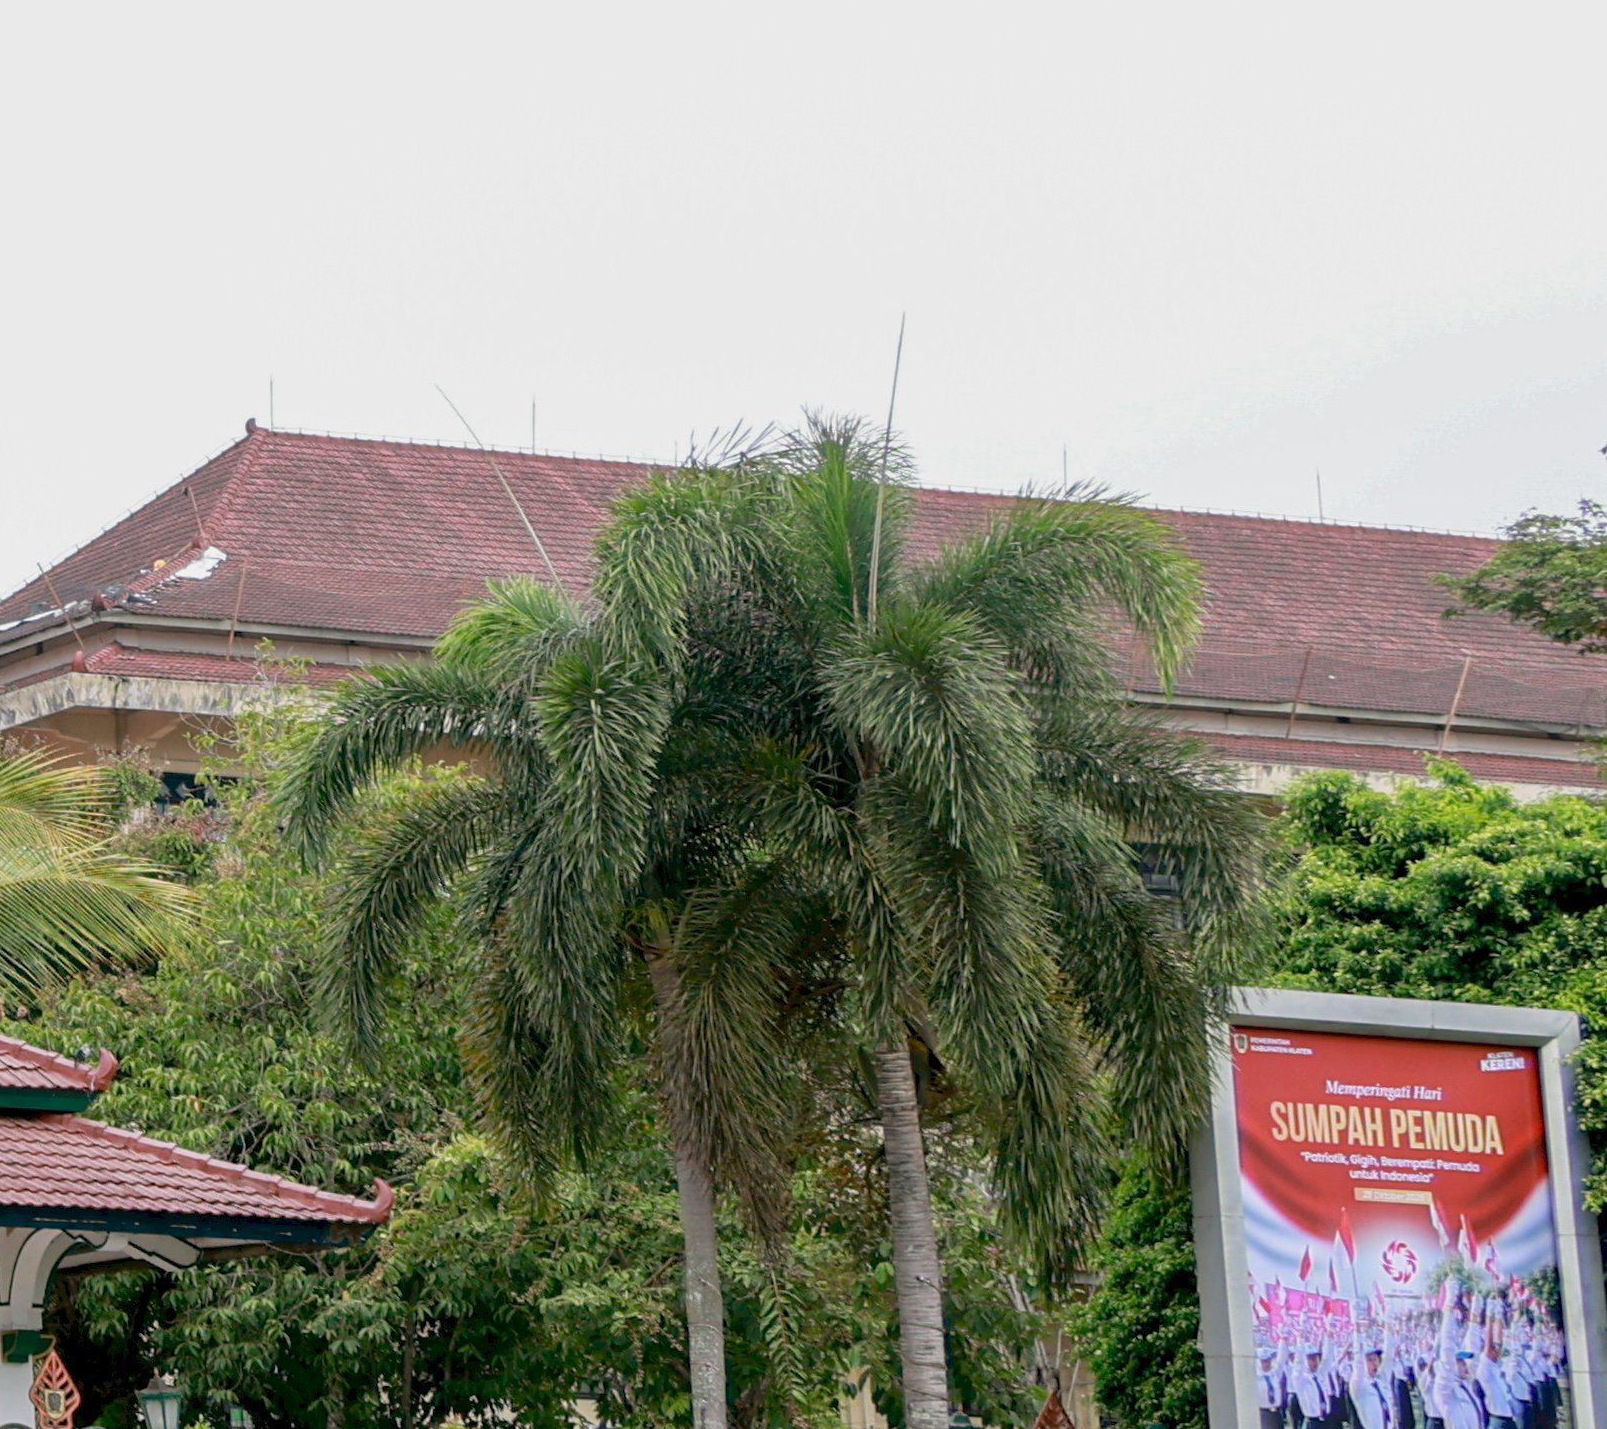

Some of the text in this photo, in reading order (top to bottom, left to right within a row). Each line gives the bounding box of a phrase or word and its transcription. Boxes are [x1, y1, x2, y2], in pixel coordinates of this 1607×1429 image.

[1325, 1080, 1443, 1101] Memperingati Hari
[1270, 1101, 1504, 1155] SUMPAH PEMUDA
[1436, 1159, 1480, 1173] Pemuda
[1349, 1170, 1379, 1180] untuk
